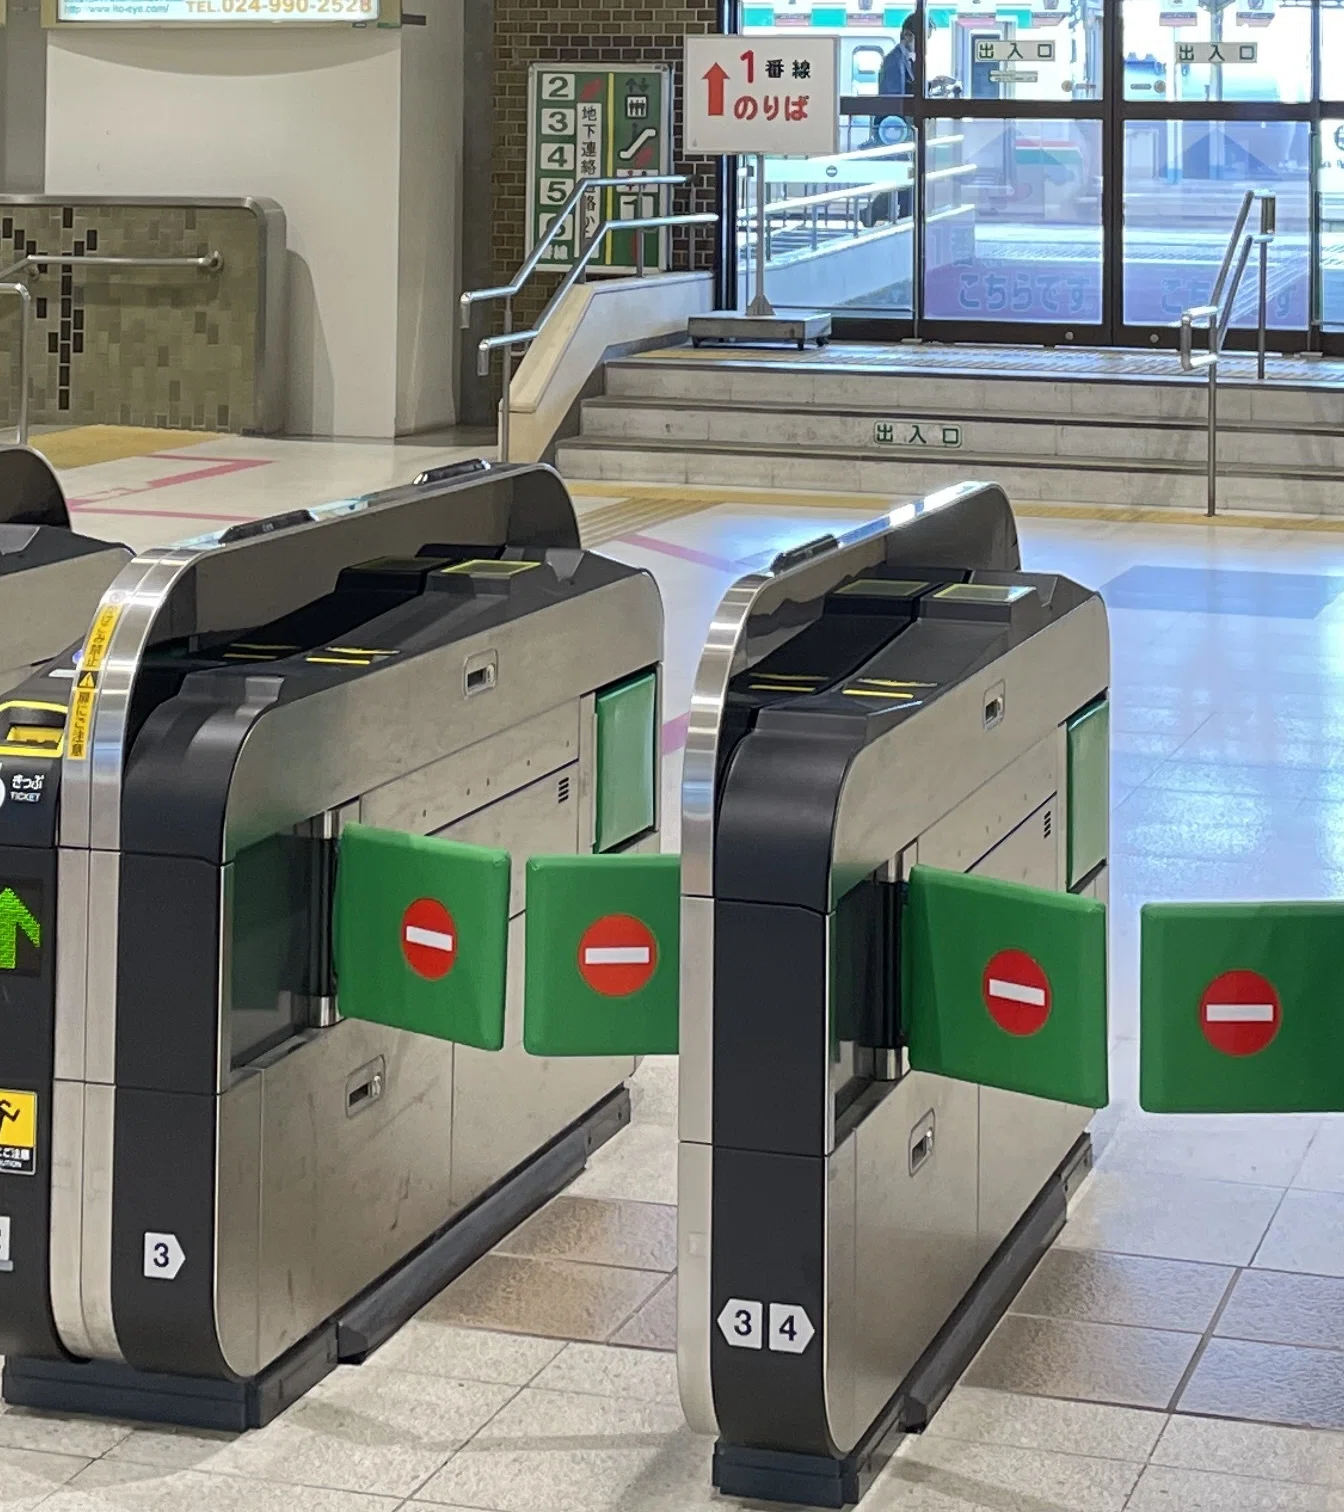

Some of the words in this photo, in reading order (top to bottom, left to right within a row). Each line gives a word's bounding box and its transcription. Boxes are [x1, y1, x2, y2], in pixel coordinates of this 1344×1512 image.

[977, 41, 1054, 61] 出入口
[1178, 44, 1256, 62] 出入口
[739, 49, 754, 84] 1
[765, 58, 811, 80] 番線
[548, 76, 568, 98] 2
[733, 95, 810, 122] のりば
[548, 110, 568, 133] 3
[547, 145, 568, 168] 4
[546, 180, 567, 202] 5
[876, 424, 959, 444] 出入口
[152, 1242, 170, 1268] 3
[733, 1310, 753, 1338] 3
[778, 1314, 798, 1341] 4
